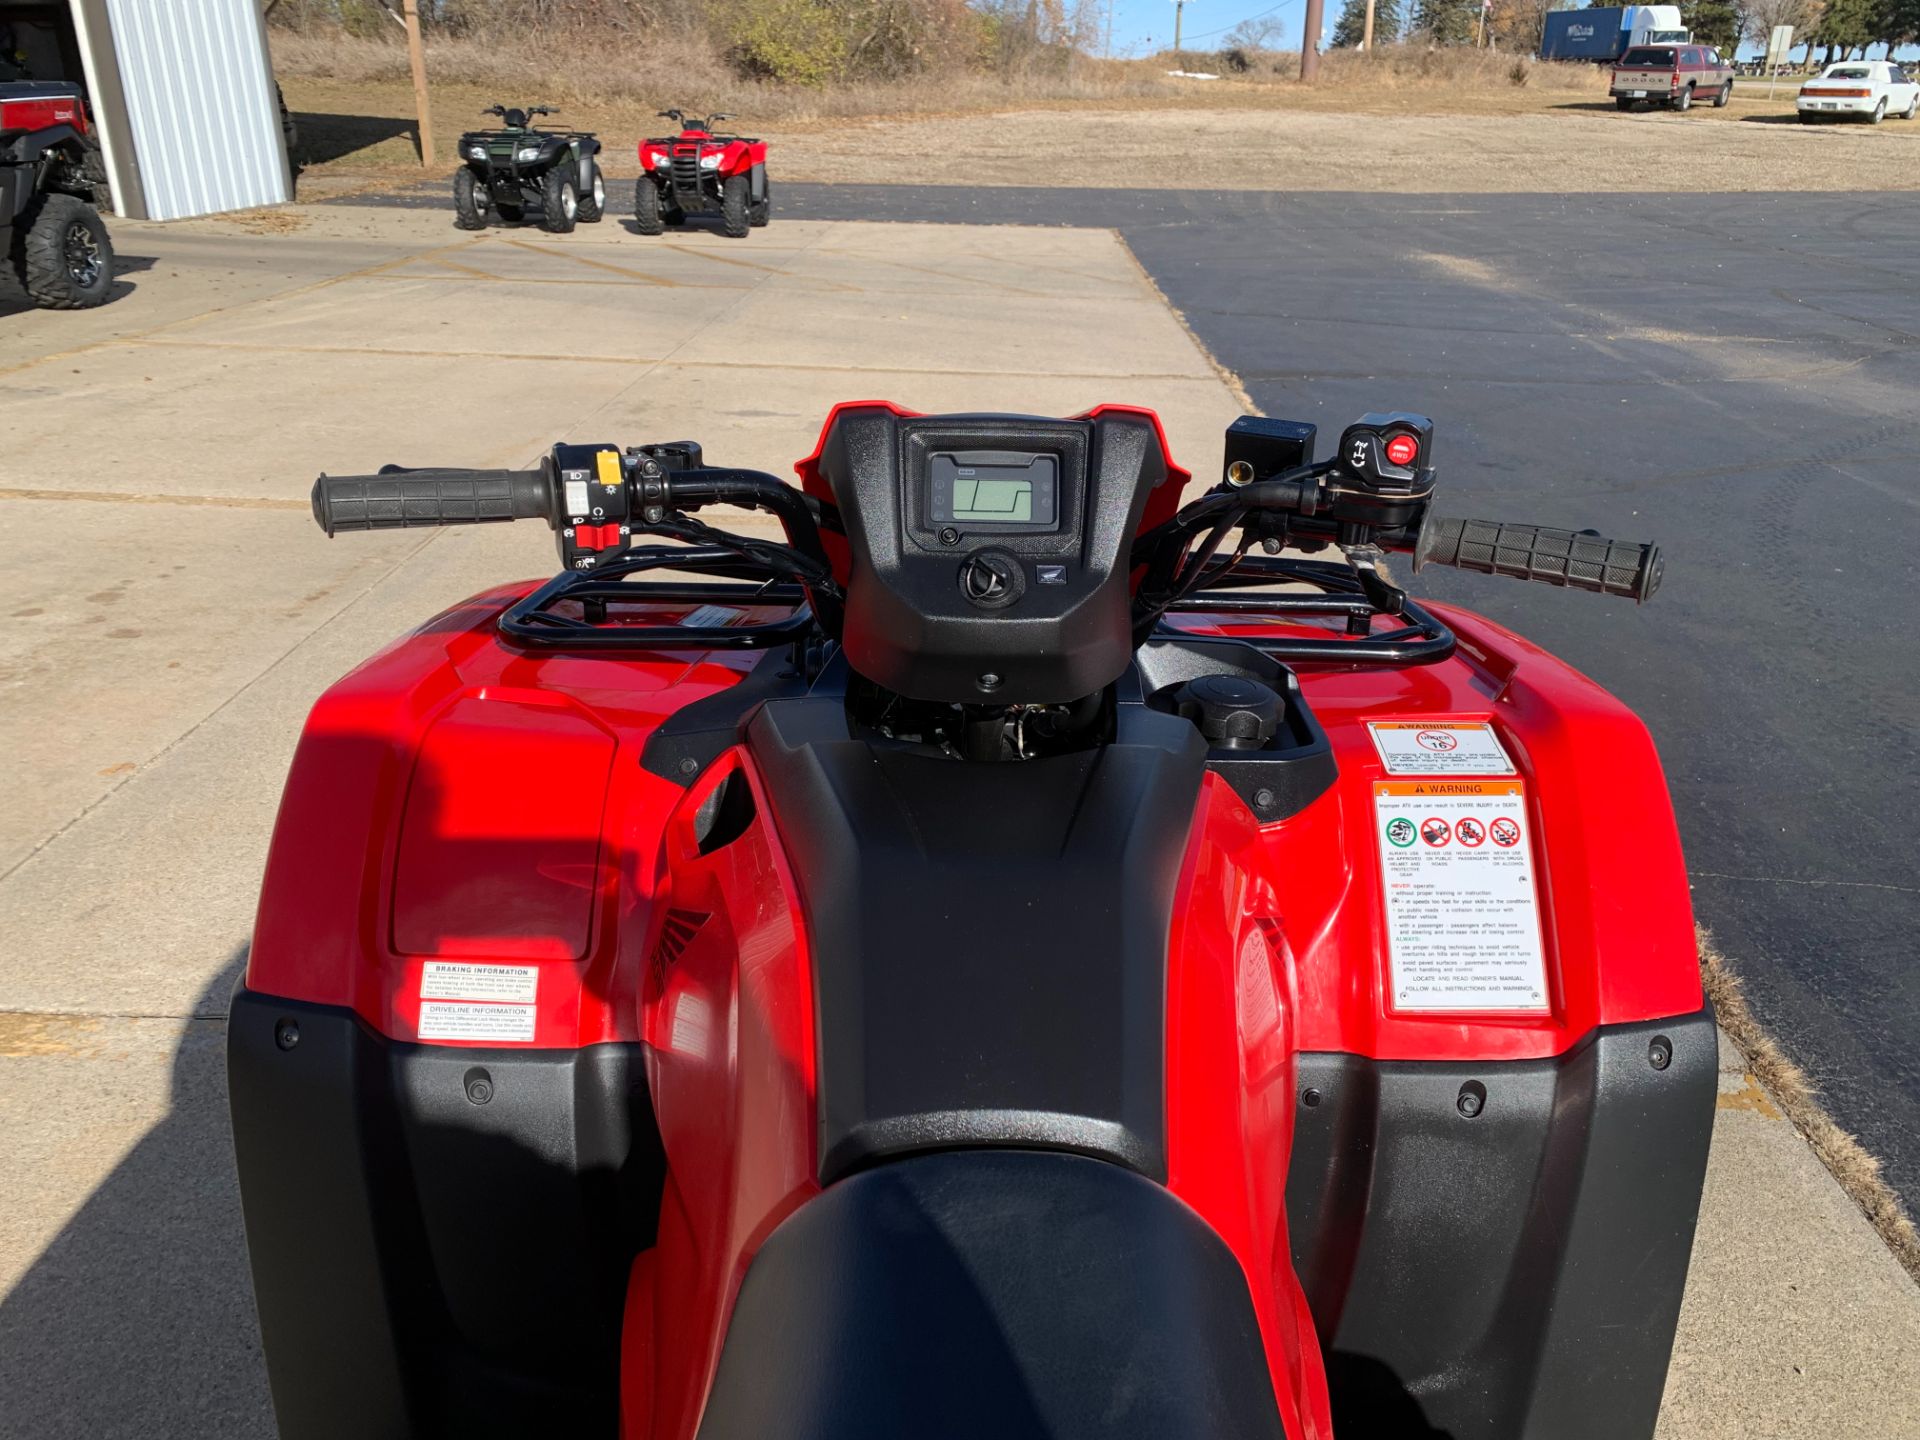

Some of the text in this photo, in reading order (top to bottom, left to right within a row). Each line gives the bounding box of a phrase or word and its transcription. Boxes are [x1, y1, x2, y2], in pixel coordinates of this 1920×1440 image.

[1429, 784, 1482, 793] WARNING
[474, 967, 528, 975] INFORMATION
[472, 1007, 526, 1015] INFORMATION
